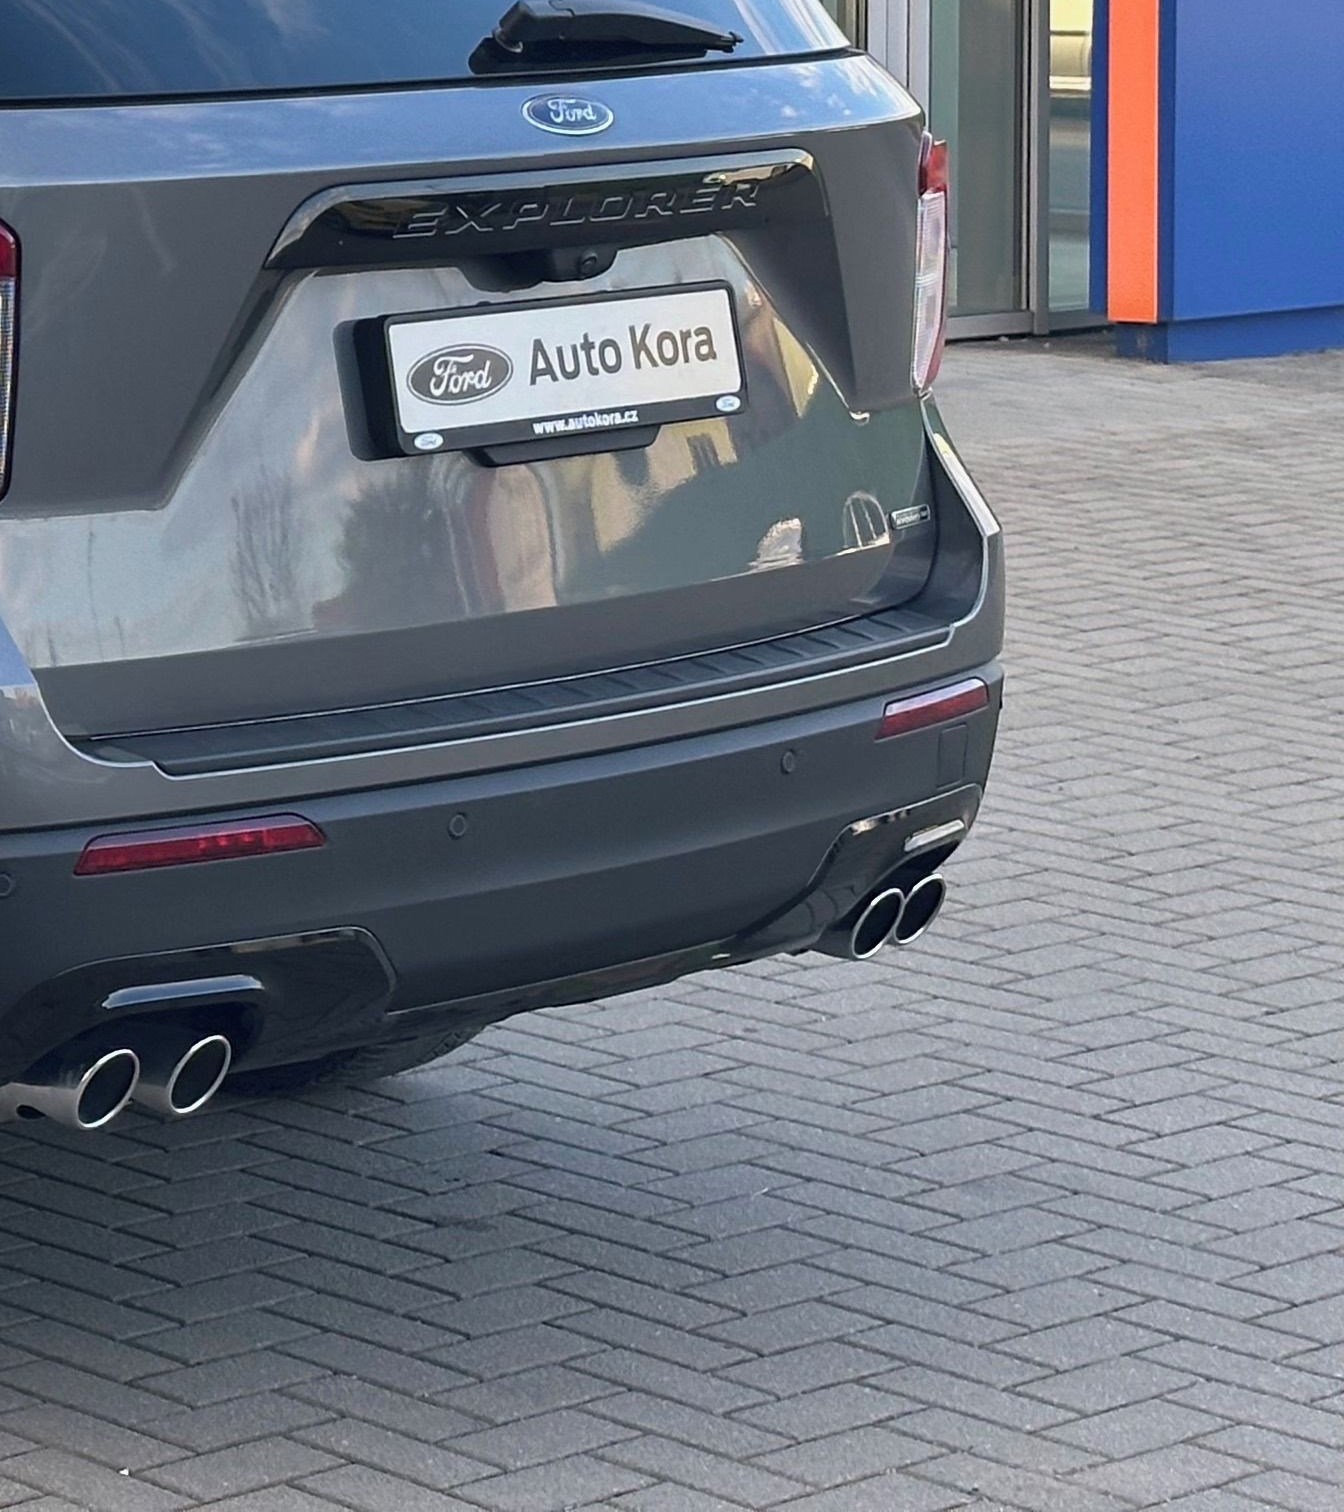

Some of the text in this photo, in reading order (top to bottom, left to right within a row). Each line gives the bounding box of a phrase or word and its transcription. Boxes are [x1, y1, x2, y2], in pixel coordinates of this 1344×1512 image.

[392, 182, 761, 239] EXPLORER
[429, 321, 718, 398] Ford Auto Kora
[532, 407, 640, 435] www.autokora.cz
